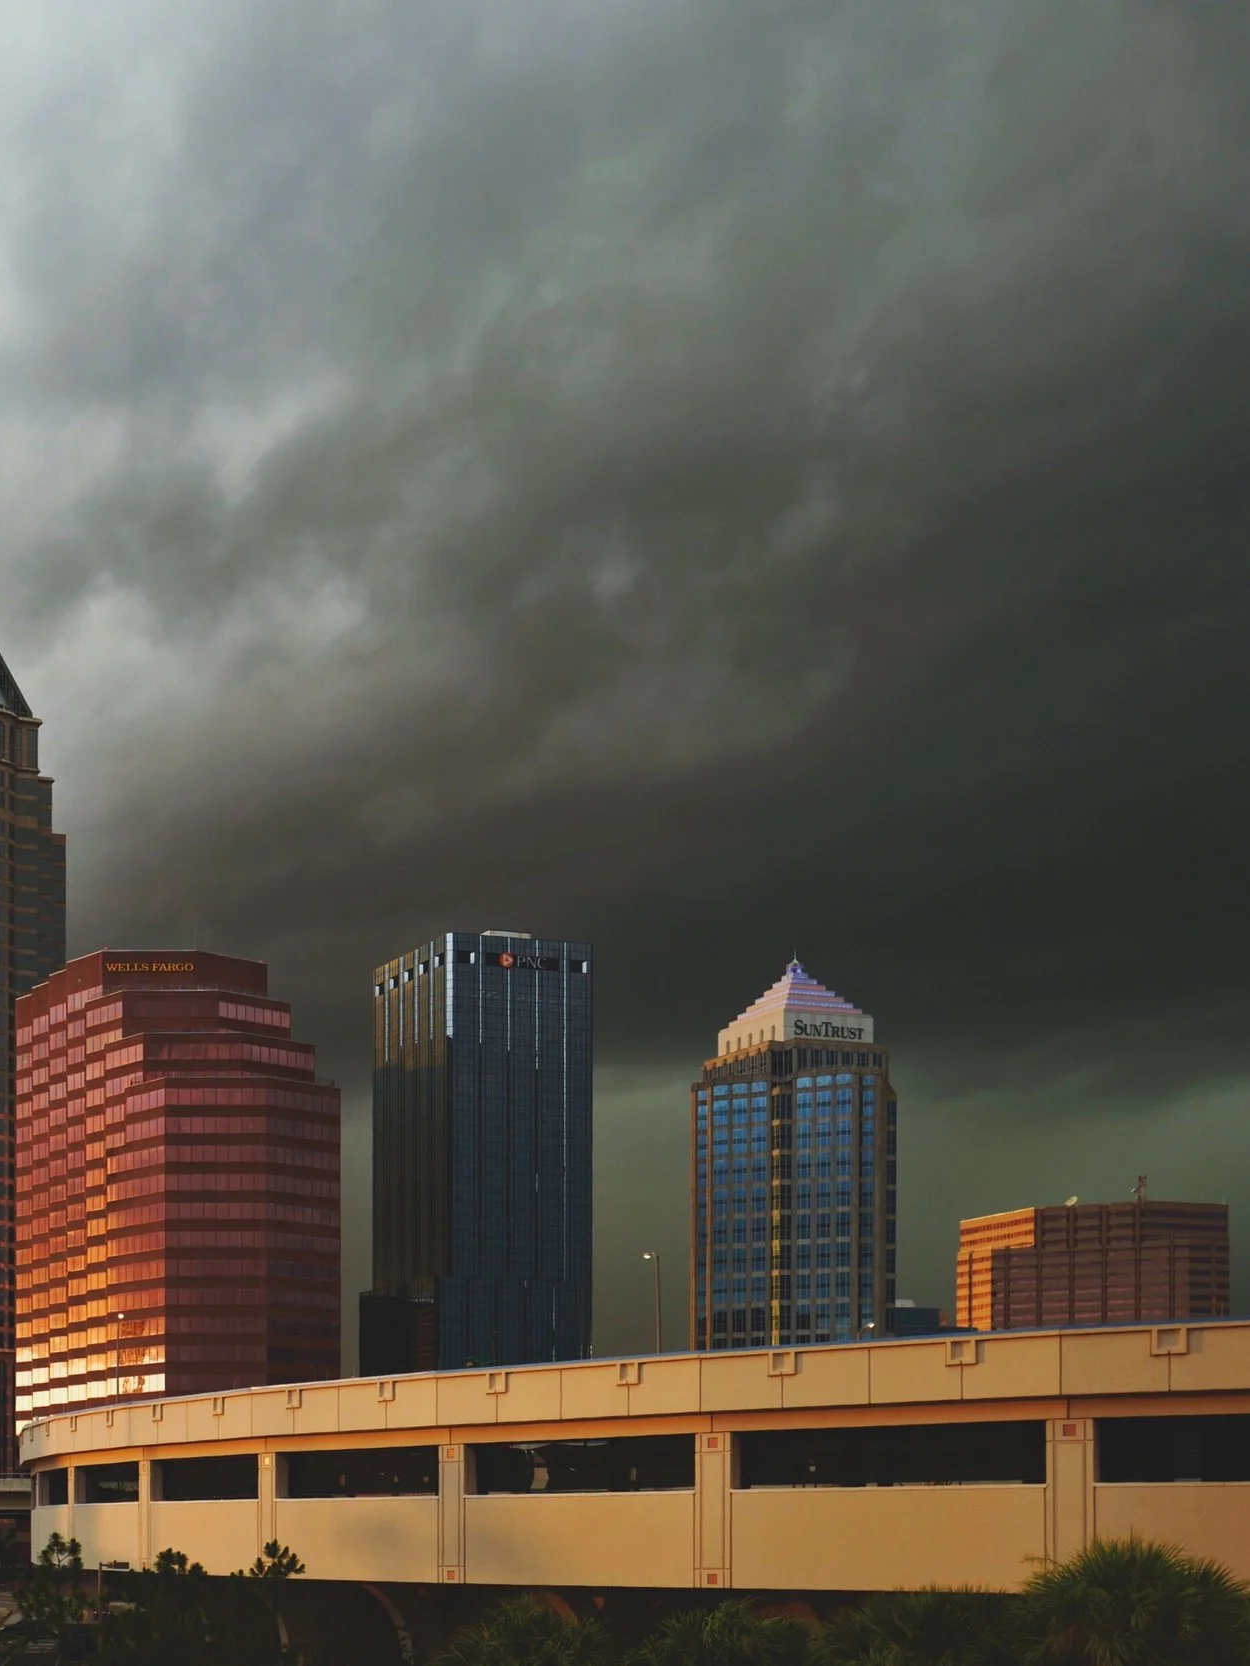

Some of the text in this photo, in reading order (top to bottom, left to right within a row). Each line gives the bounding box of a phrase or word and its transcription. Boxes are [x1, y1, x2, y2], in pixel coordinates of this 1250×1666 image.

[106, 962, 194, 972] WELLS FARGO
[517, 955, 546, 969] PNC
